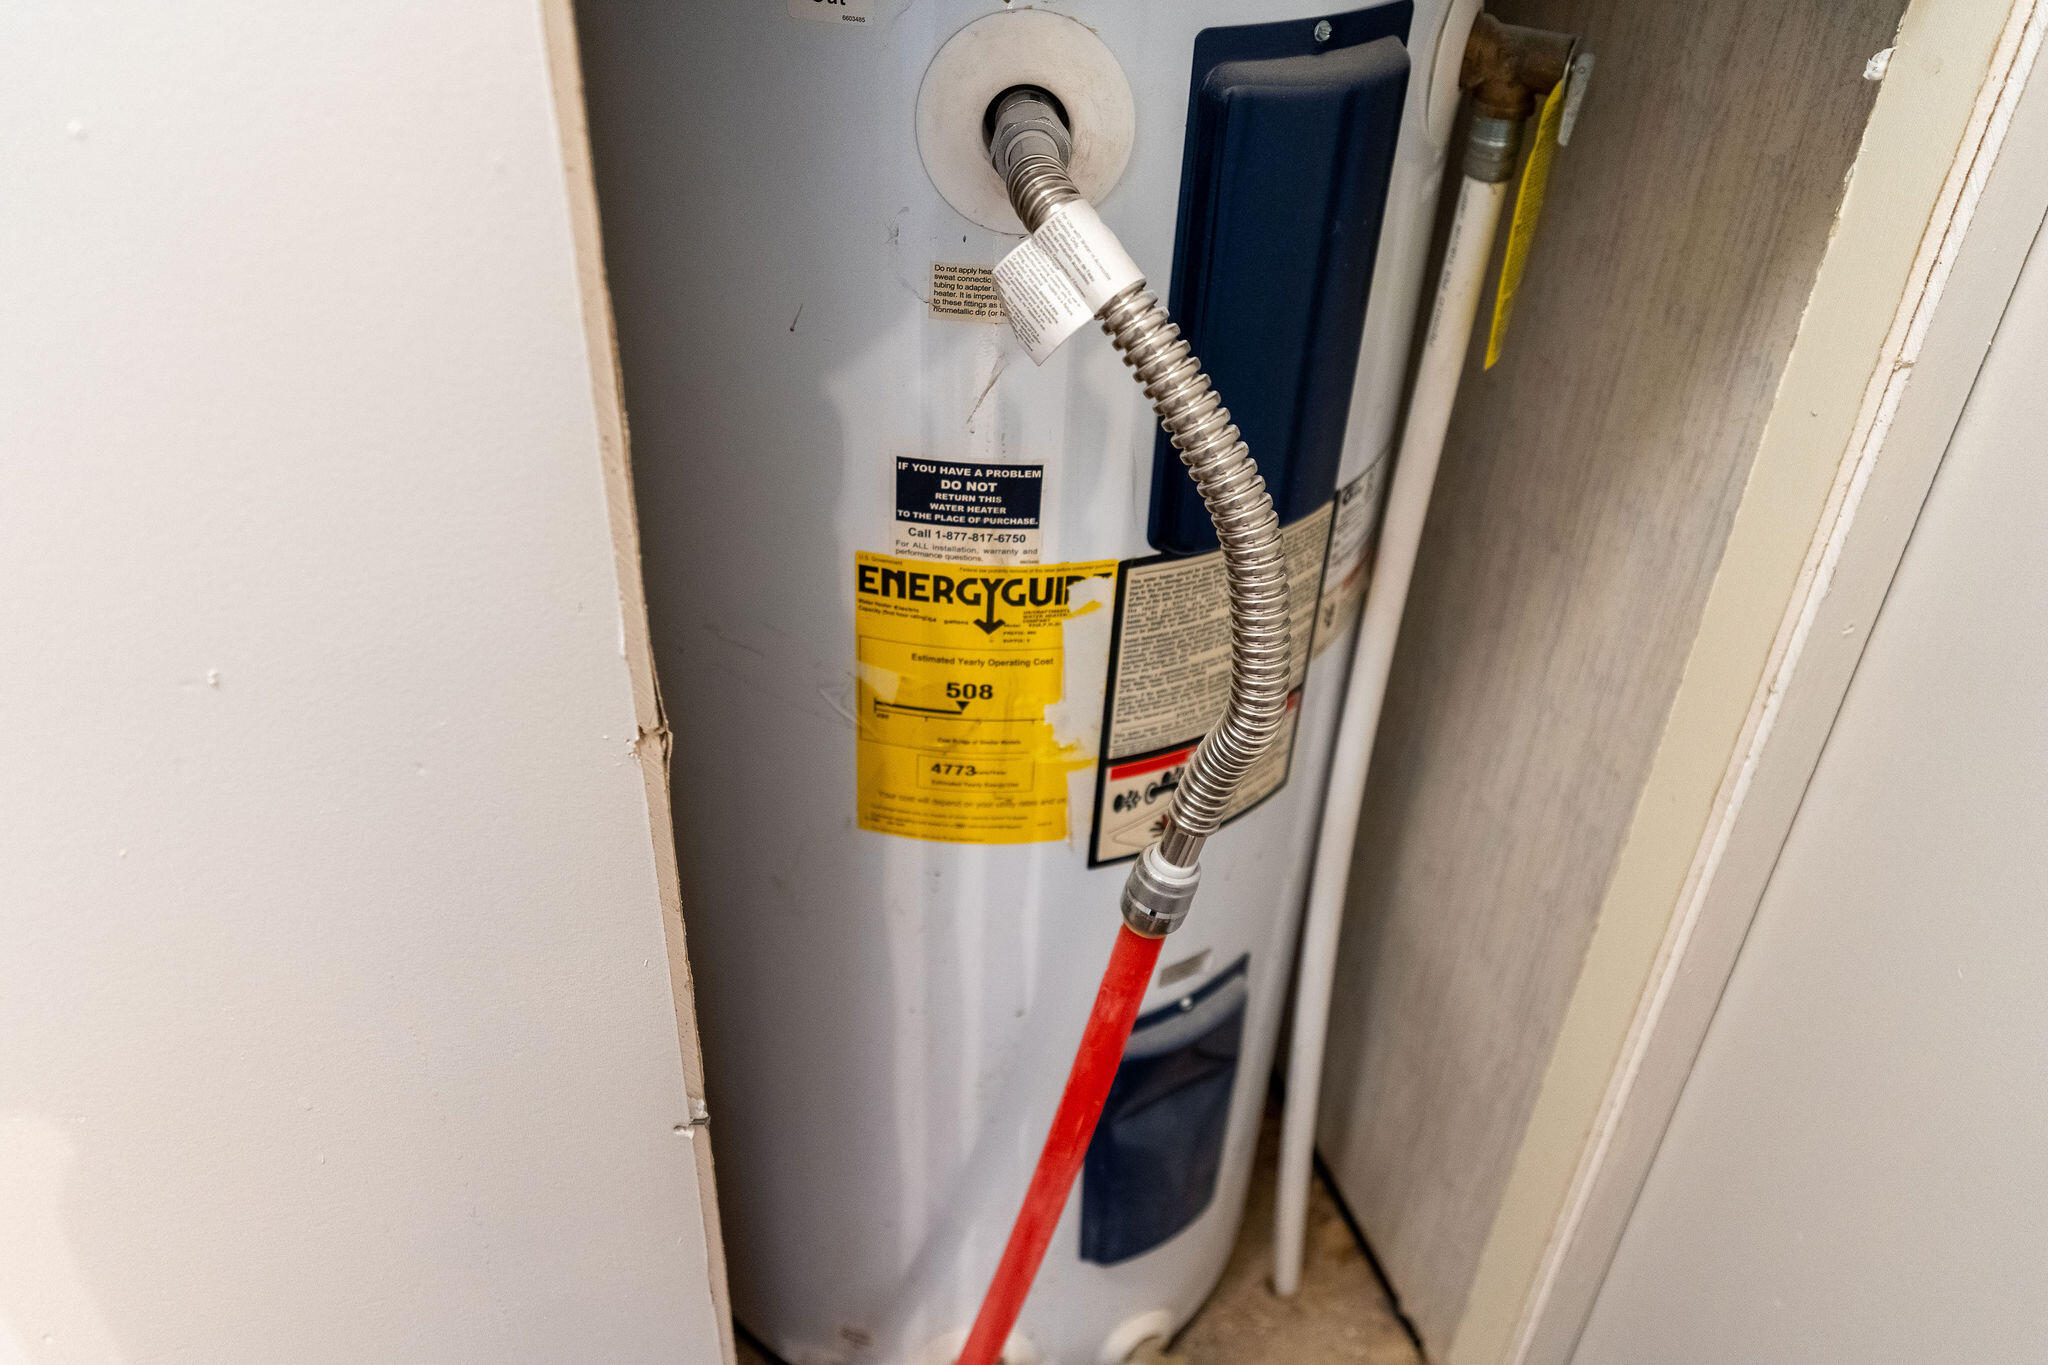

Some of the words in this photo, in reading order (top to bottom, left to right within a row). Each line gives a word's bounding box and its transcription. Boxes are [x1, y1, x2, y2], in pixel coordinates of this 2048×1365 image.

[946, 265, 957, 273] not
[958, 267, 977, 275] apply
[957, 275, 992, 283] connectio
[934, 281, 955, 289] tubing
[965, 284, 991, 292] adapter
[933, 289, 958, 298] heater.
[973, 293, 998, 301] impera
[933, 305, 974, 315] nonmetallic
[987, 309, 998, 317] (or
[898, 462, 909, 470] IF
[912, 463, 937, 473] YOU
[940, 466, 971, 476] HAVE
[974, 469, 983, 477] A
[986, 469, 1042, 478] PROBLEM
[941, 480, 962, 490] DO
[966, 482, 998, 492] NOT
[935, 492, 976, 502] RETURN
[978, 495, 1002, 503] THIS
[929, 503, 964, 512] WATER
[967, 506, 1007, 514] HEATER
[897, 509, 911, 517] TO
[913, 511, 932, 520] THE
[934, 514, 966, 523] PLACE
[983, 517, 1039, 525] PURCHASE.
[908, 527, 931, 538] Call
[935, 530, 1026, 543] 1-877-817-6750
[896, 548, 943, 558] performance
[945, 553, 983, 561] questions.
[983, 547, 1019, 555] warranty
[858, 564, 1112, 608] ENERGYGUI
[911, 653, 955, 664] Estimated
[958, 657, 985, 667] Yearly
[988, 659, 1031, 667] Operating
[1033, 658, 1054, 666] Cost
[946, 682, 994, 699] 508
[931, 763, 977, 776] 4773
